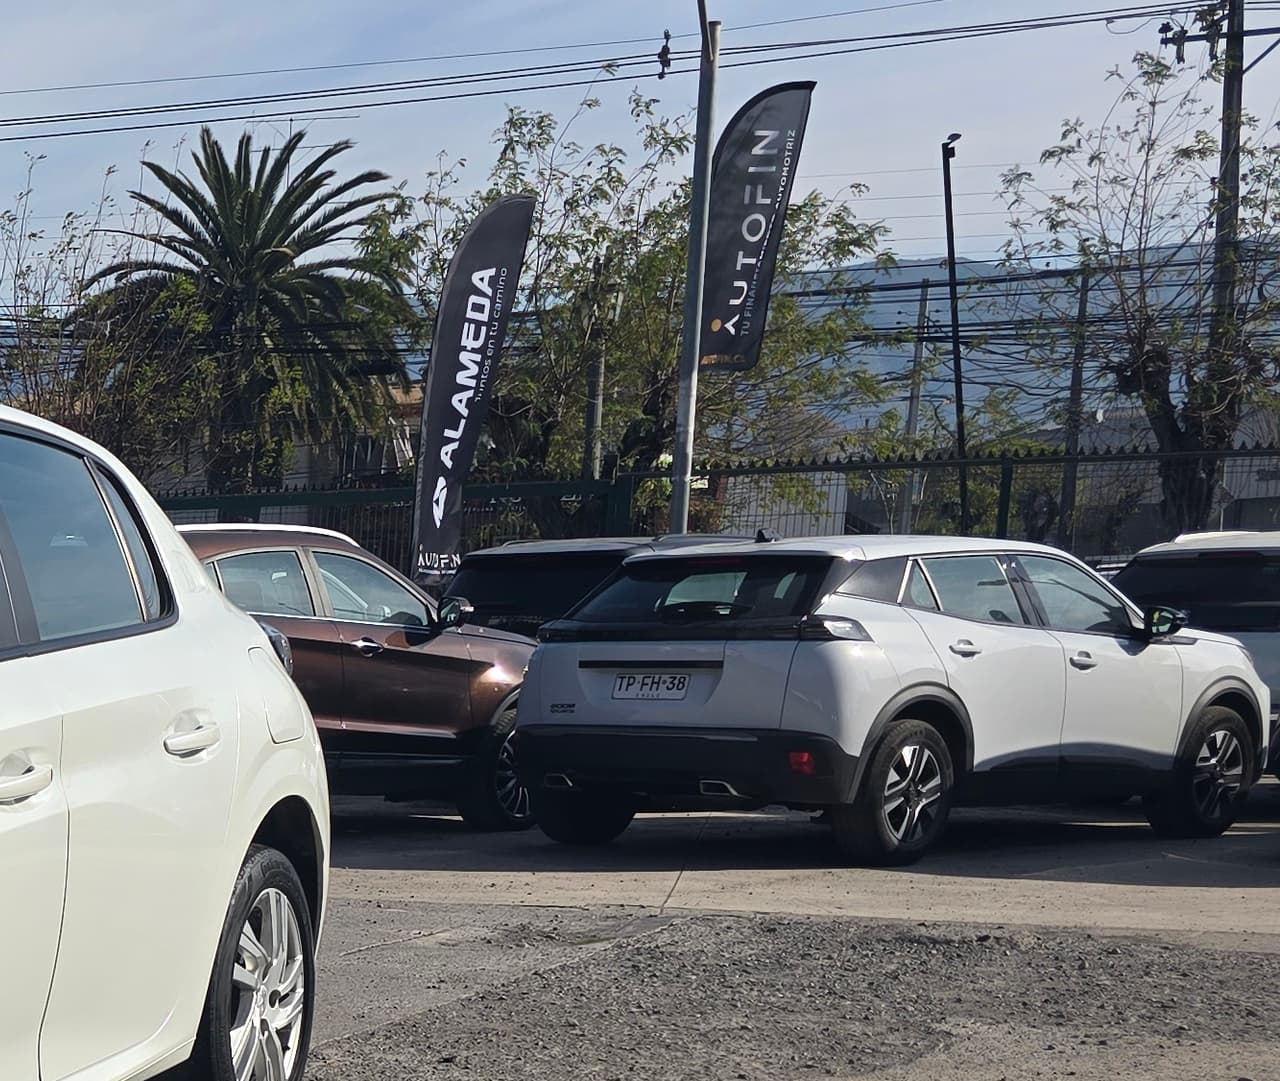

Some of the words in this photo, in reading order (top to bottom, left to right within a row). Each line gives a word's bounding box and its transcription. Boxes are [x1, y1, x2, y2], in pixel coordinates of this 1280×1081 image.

[723, 129, 781, 336] AUTOFIN
[493, 267, 507, 318] camino
[487, 339, 496, 356] en
[488, 321, 499, 336] tu
[440, 267, 497, 469] ALAMEDA
